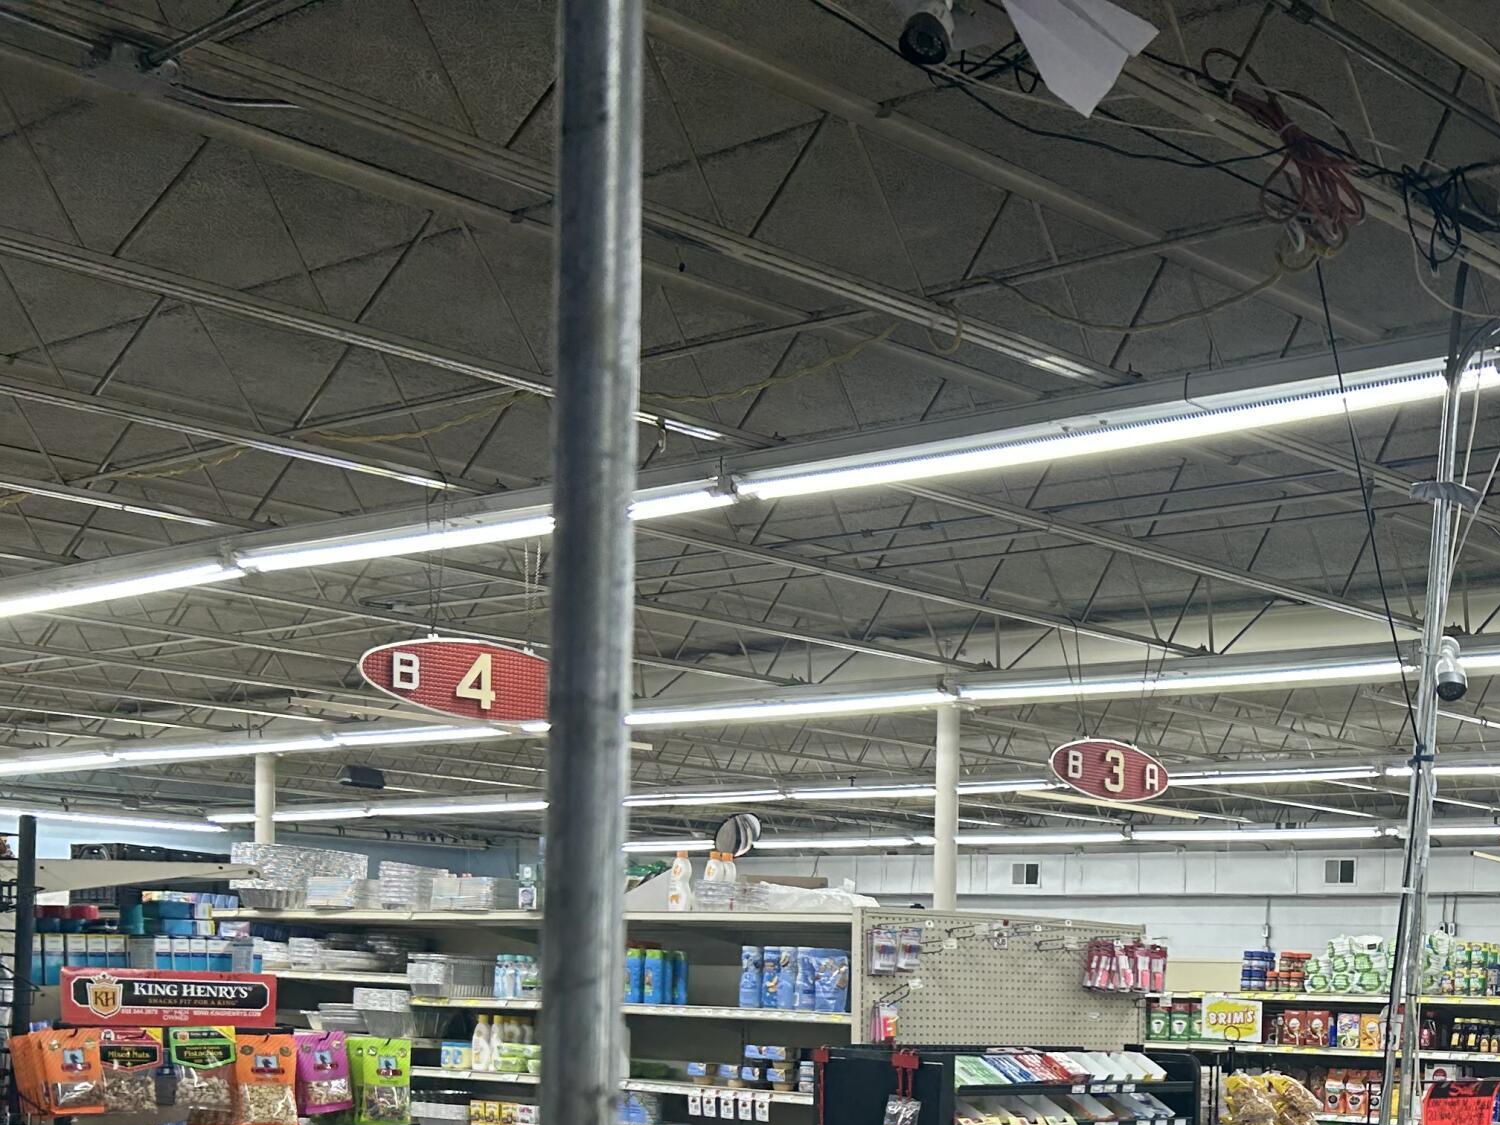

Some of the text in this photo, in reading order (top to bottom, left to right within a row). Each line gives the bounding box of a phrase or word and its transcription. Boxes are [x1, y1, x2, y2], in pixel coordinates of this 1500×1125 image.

[393, 652, 496, 709] B 4
[1068, 749, 1159, 793] B 3 A
[94, 990, 116, 1007] KH
[133, 982, 249, 999] KING HENRY'S
[1208, 1008, 1255, 1026] BRIM'S
